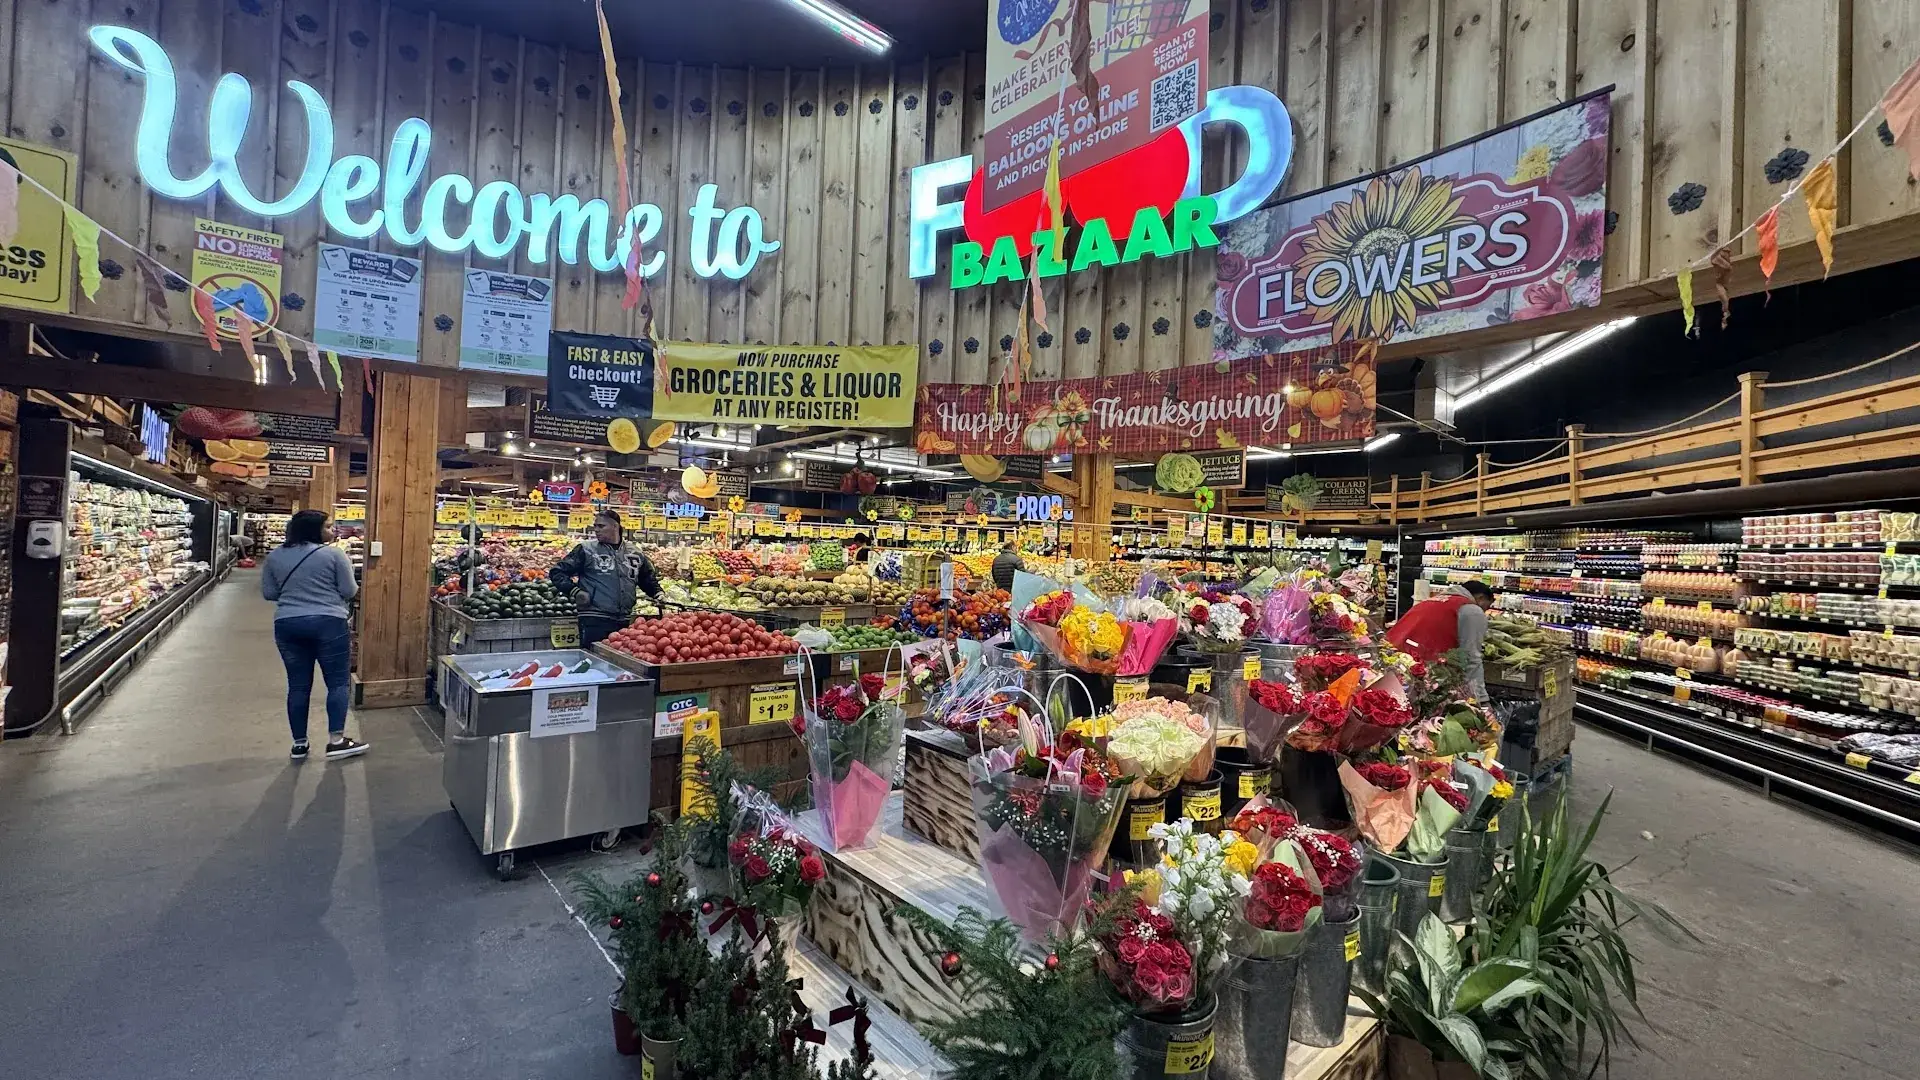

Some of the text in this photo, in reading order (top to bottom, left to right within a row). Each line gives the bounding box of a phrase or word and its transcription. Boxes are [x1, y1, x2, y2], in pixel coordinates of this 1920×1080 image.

[1153, 28, 1196, 58] SCAN TO
[1154, 37, 1195, 67] RESERVE
[990, 13, 1141, 115] CELEBRATIO SHINE!
[992, 38, 1071, 99] MAKE EVERY
[1160, 51, 1188, 74] NOW!
[1011, 84, 1111, 148] RESERVE YOR
[988, 88, 1139, 178] BALLOONS ONLINE
[90, 25, 781, 280] Welcome to
[996, 168, 1019, 191] AND
[1068, 116, 1129, 156] IN-STORE
[198, 233, 237, 255] NO
[200, 223, 280, 246] SAFETY FIRST!
[951, 195, 1221, 290] BAZAAR
[238, 242, 273, 253] SANDALS
[333, 271, 347, 279] OUR
[352, 257, 390, 270] REWARDS
[1257, 211, 1530, 320] FLOWERS
[567, 345, 645, 367] FAST & EASY
[737, 352, 841, 369] NOW PURCHASE
[568, 364, 642, 385] Checkout!
[670, 367, 902, 401] GROCERIES & LIQUOR
[712, 399, 860, 421] AT ANY REGISTER!
[936, 390, 1286, 445] Happy Thanksgiving
[808, 462, 833, 472] APPLE
[1200, 455, 1241, 466] LETTUCE
[1324, 480, 1366, 489] COLLARD
[1332, 487, 1366, 495] GREENS
[671, 698, 693, 711] OTC
